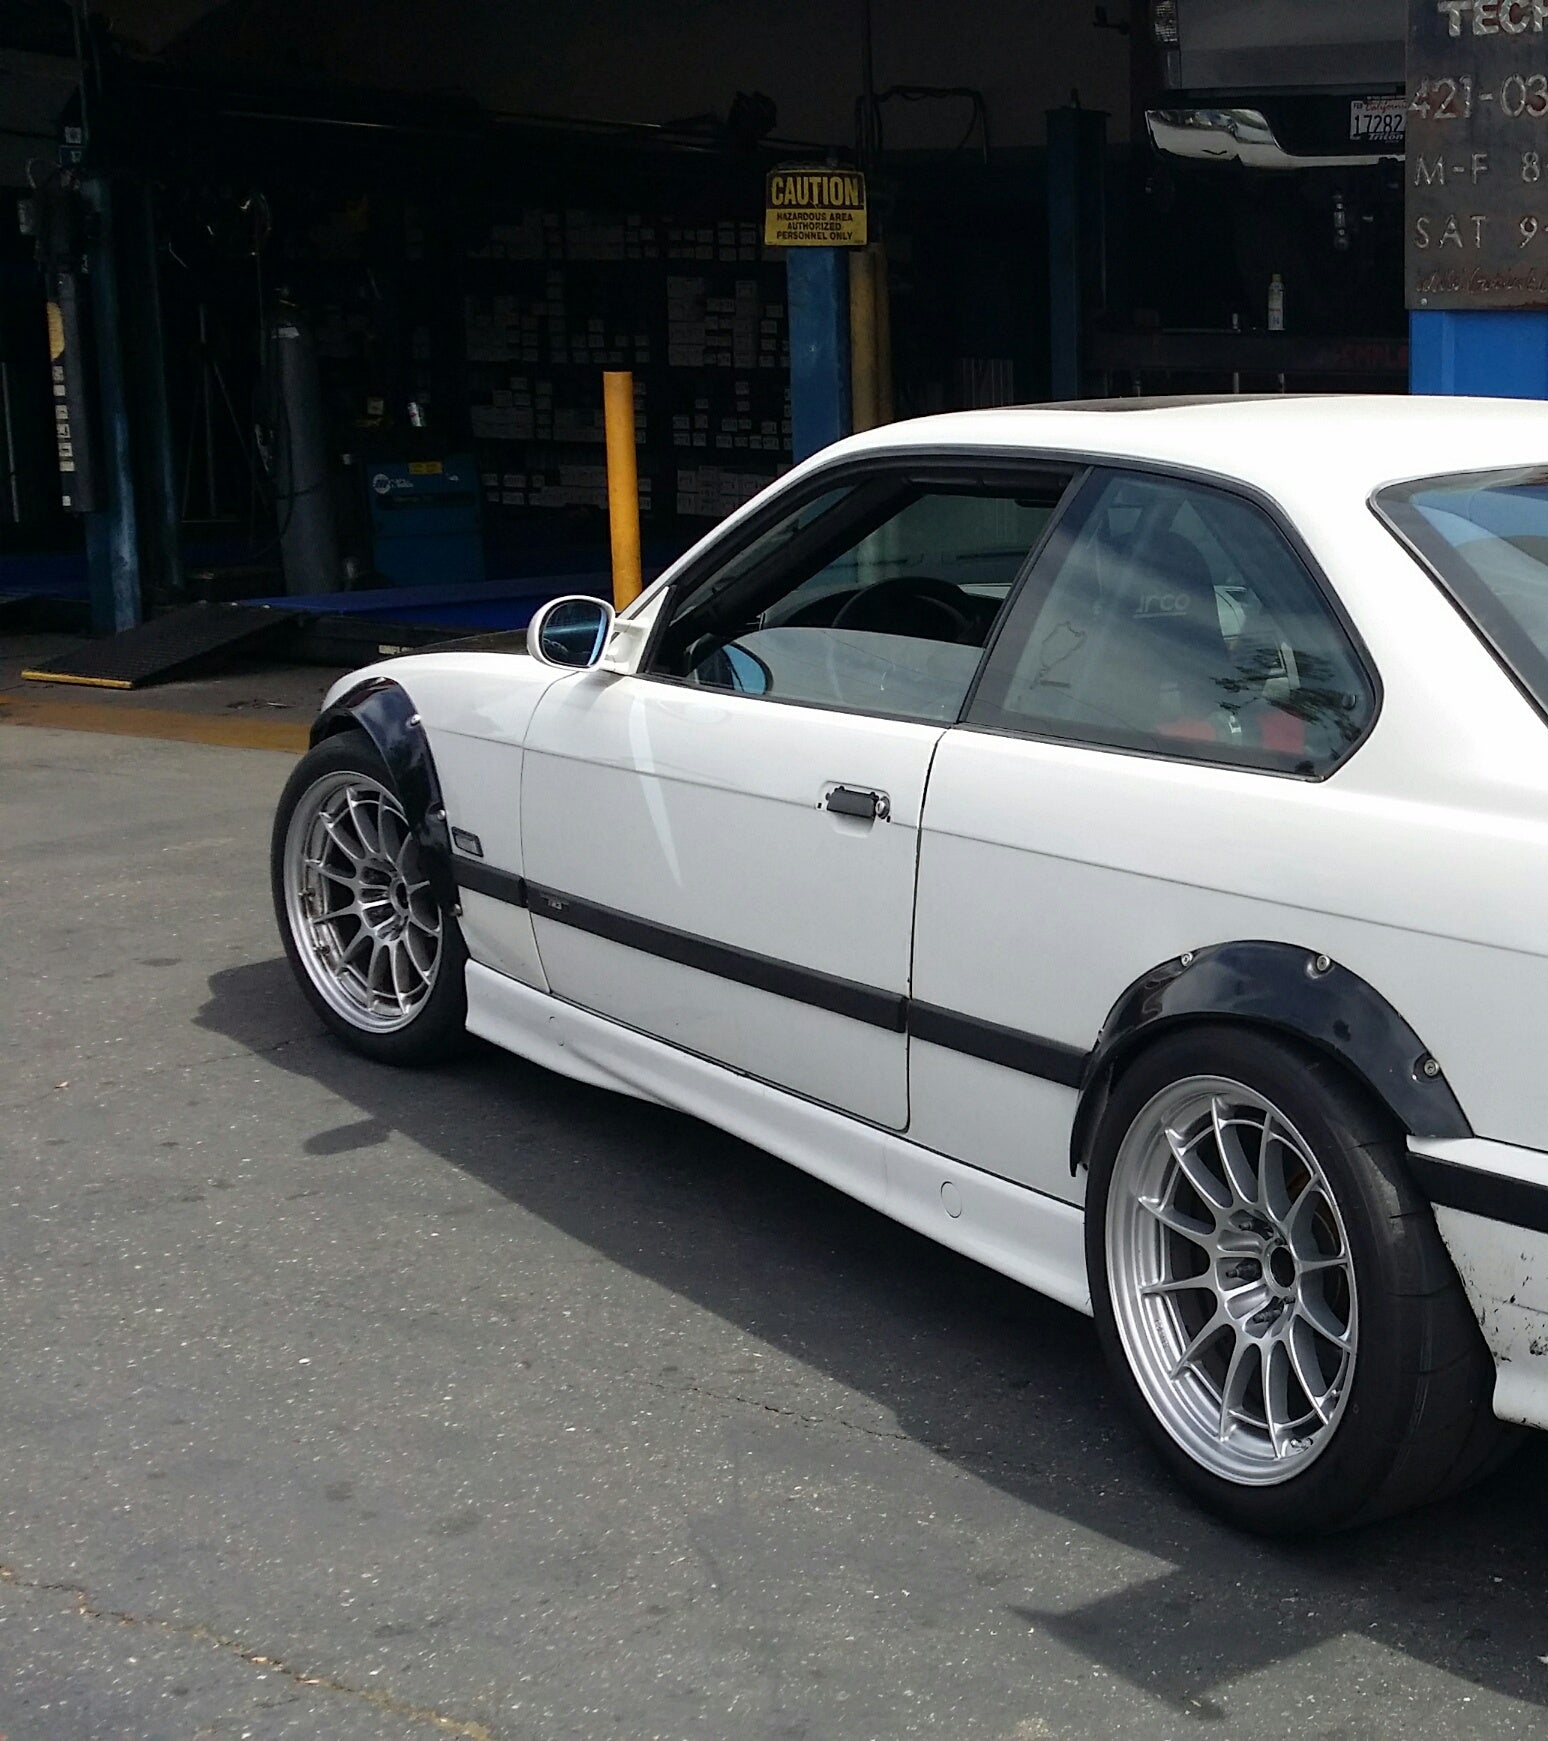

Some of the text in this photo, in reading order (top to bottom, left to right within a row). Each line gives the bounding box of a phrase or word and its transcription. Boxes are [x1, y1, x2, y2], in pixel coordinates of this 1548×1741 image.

[1414, 153, 1488, 186] M-F
[771, 176, 859, 206] CAUTION
[776, 213, 854, 221] HAZARDOUS AREA
[787, 222, 842, 231] AUTHORIZED
[776, 231, 853, 240] PERSONNEL ONLY
[1416, 214, 1486, 248] SAT
